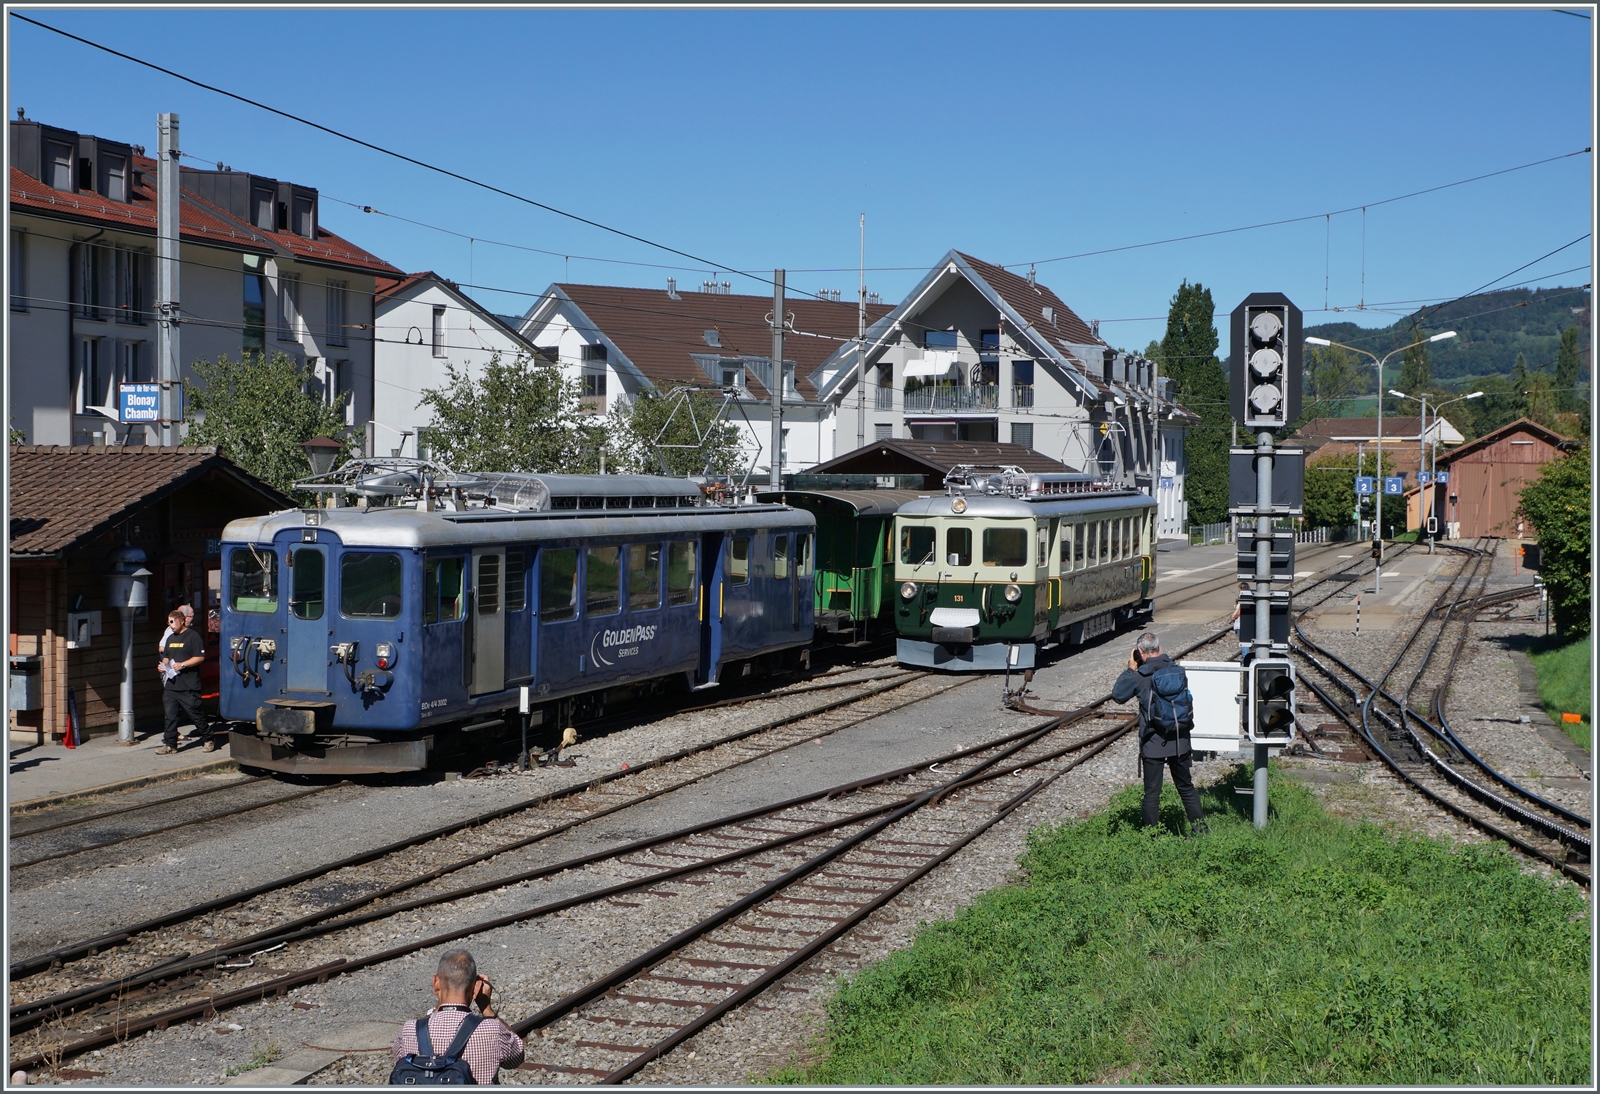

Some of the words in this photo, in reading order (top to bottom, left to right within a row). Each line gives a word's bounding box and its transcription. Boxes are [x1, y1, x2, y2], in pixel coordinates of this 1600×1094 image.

[127, 394, 156, 407] Blonay
[125, 408, 158, 420] Chamby
[1361, 483, 1367, 491] 2
[1391, 484, 1397, 492] 3
